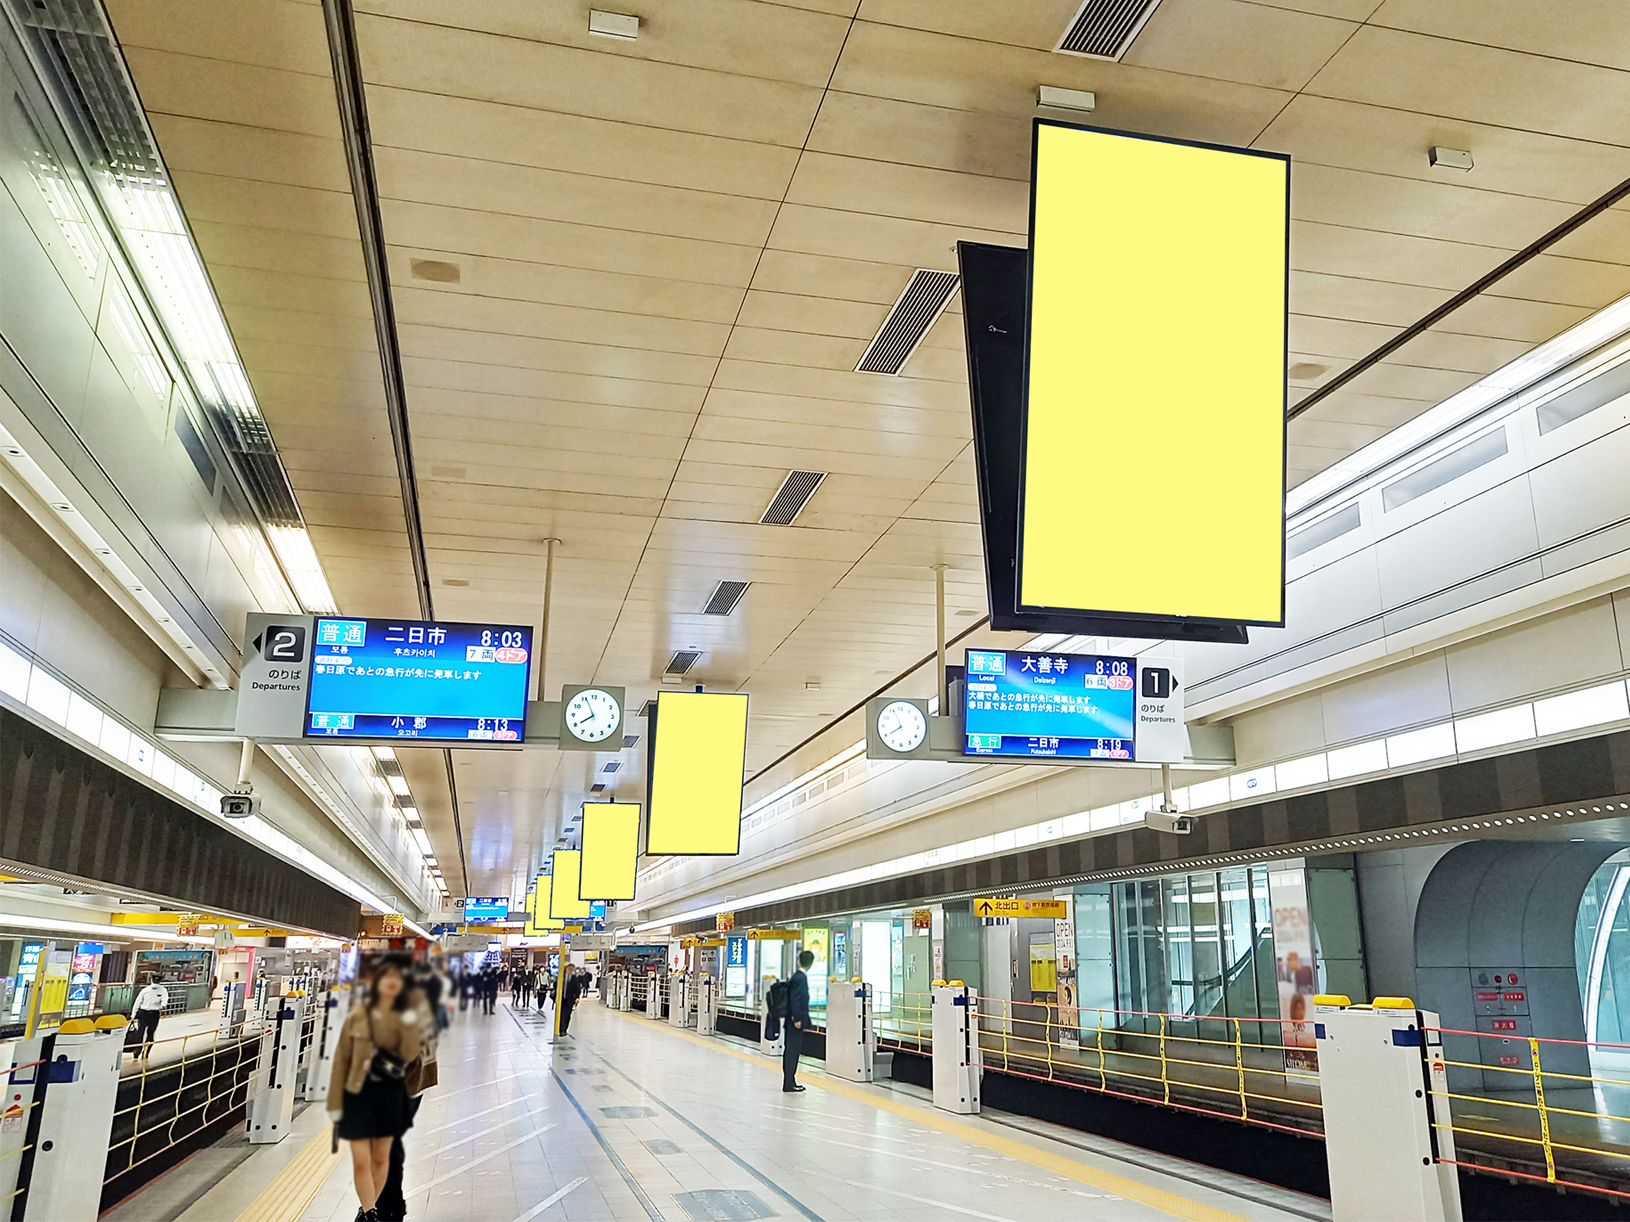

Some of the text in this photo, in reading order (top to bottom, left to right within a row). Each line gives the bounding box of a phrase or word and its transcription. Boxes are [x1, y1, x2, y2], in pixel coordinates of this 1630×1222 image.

[321, 624, 362, 642] 普通
[385, 627, 447, 646] 二日市
[481, 630, 522, 648] 8:03
[273, 632, 297, 657] 2
[497, 650, 526, 662] 4ドア
[971, 655, 1003, 672] 普通
[1021, 656, 1069, 674] 大善寺
[1095, 660, 1128, 676] 8:08
[268, 669, 302, 680] のりば
[316, 665, 482, 681] 春日原であとの急行が先に発車します
[252, 682, 301, 691] Departures
[1108, 677, 1133, 689] 3ドア
[1151, 672, 1159, 694] 1
[1141, 704, 1165, 713] のりば
[317, 715, 350, 728] 普通
[391, 716, 427, 729] 小郡
[477, 718, 508, 731] 8:13
[1141, 715, 1176, 723] Departures
[972, 735, 998, 747] 急行
[1028, 737, 1059, 748] 二日市
[1097, 739, 1121, 750] 8:19
[995, 901, 1019, 911] 北出口
[1056, 922, 1074, 938] OPEN
